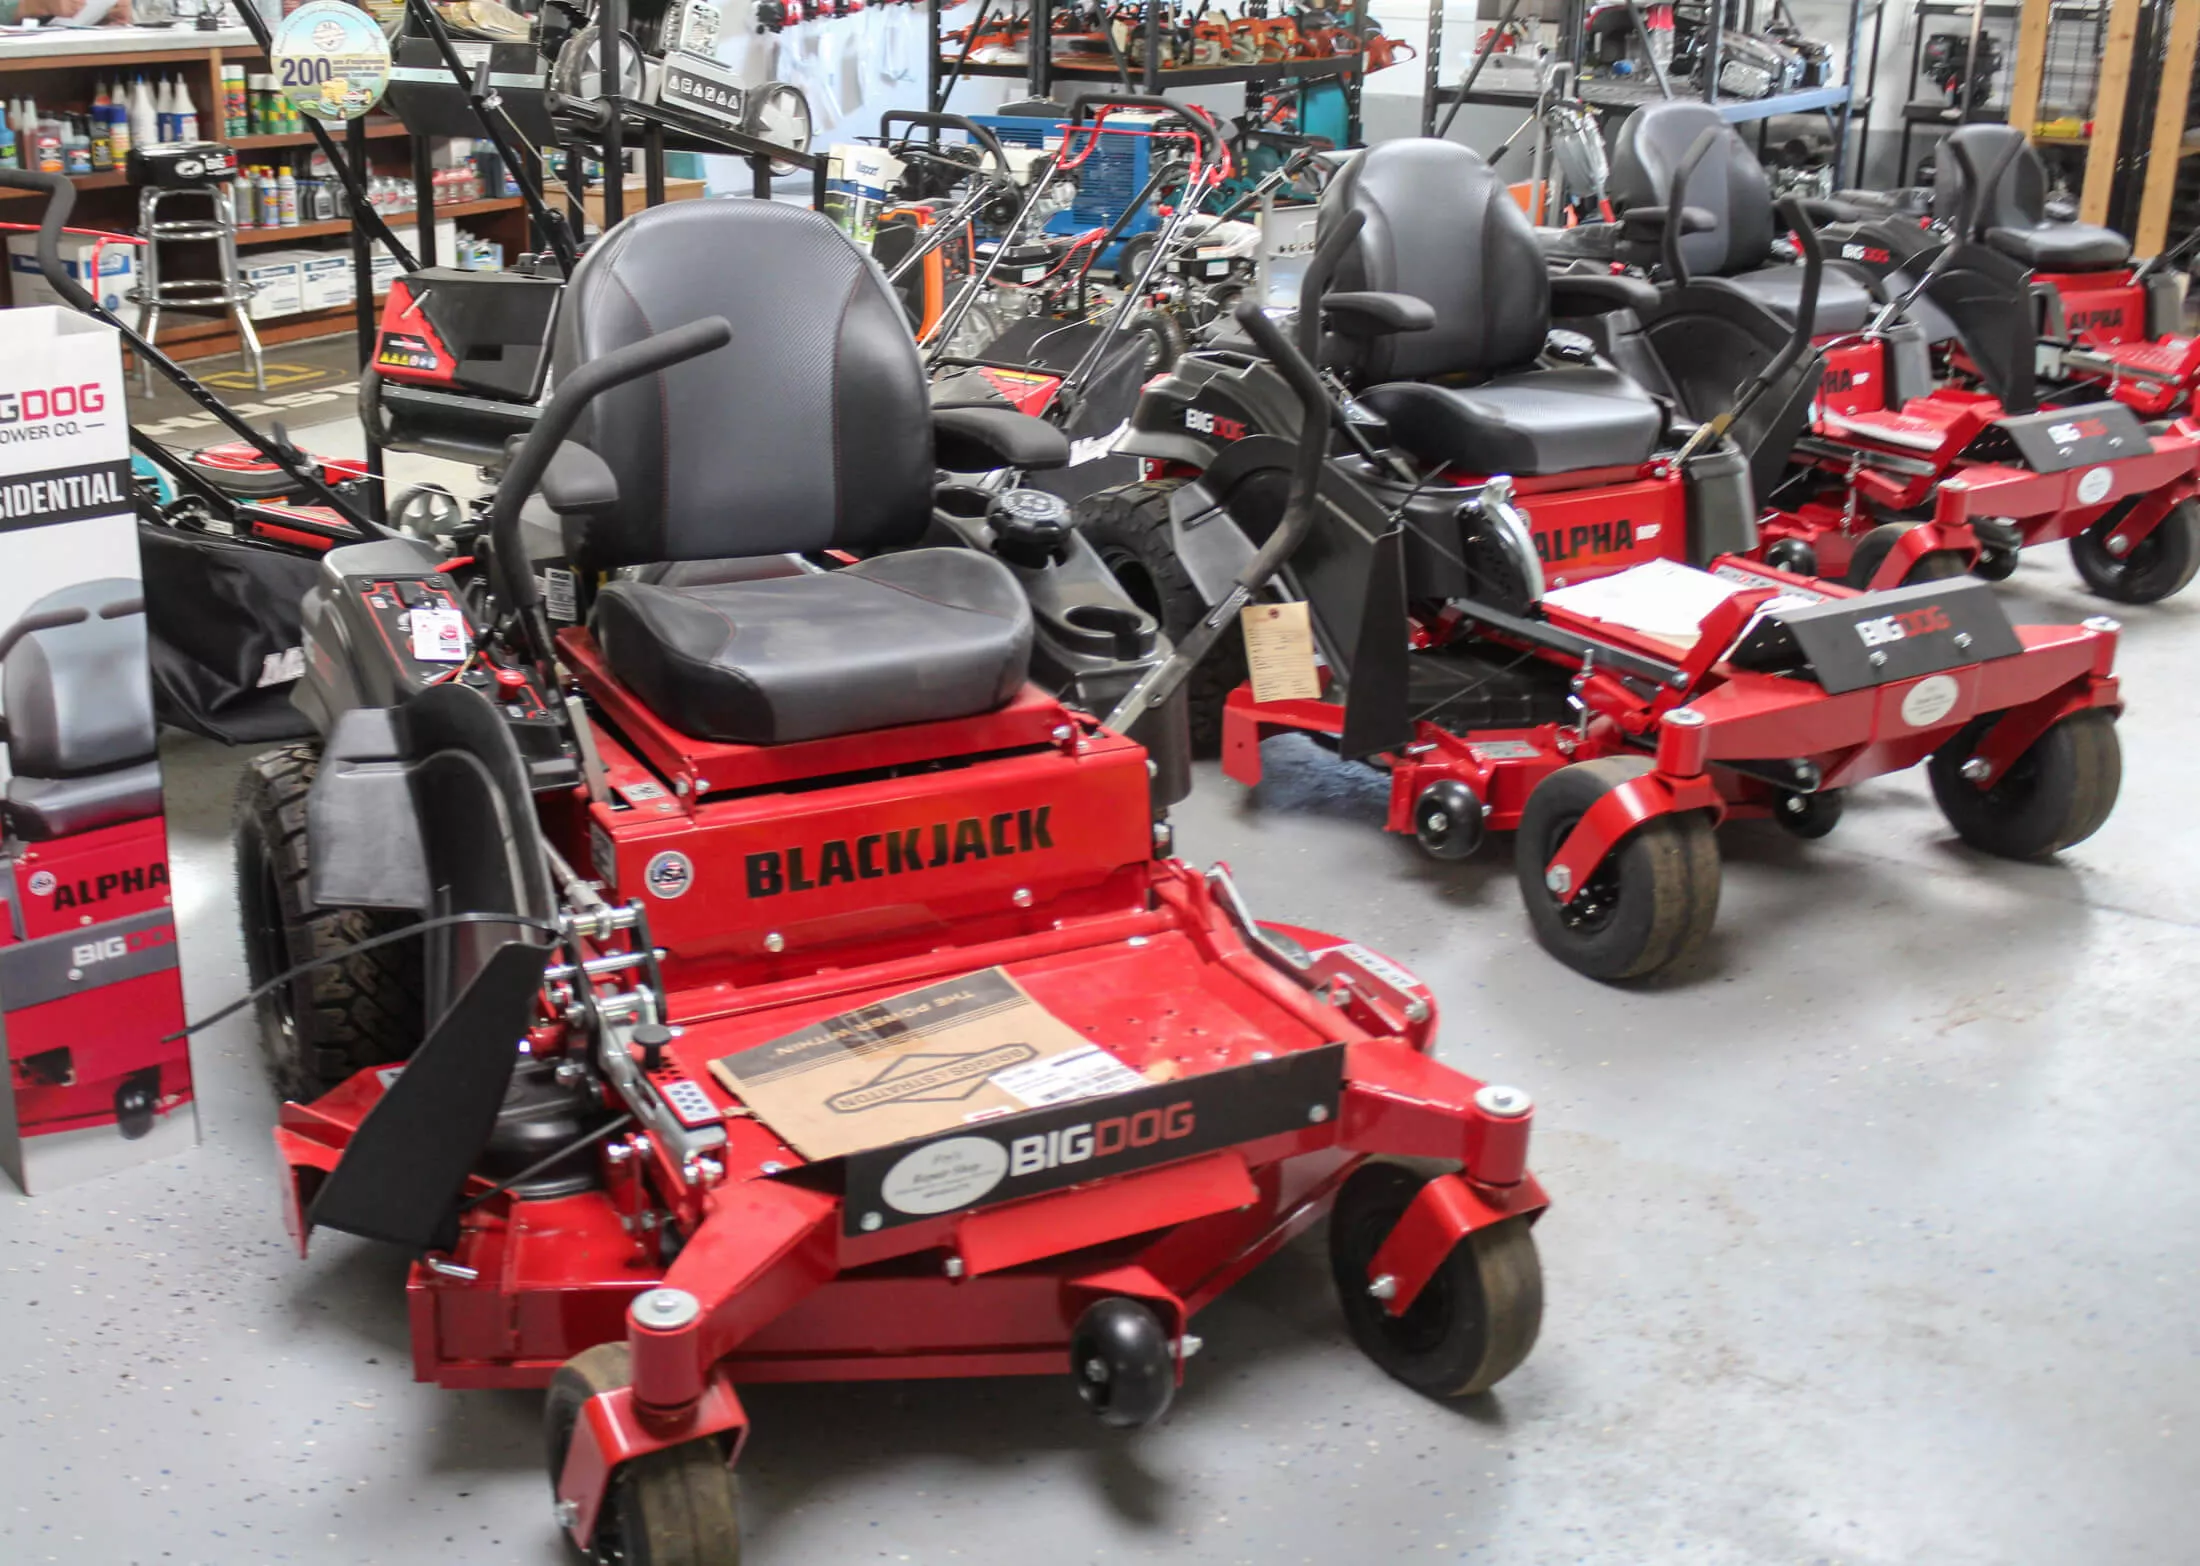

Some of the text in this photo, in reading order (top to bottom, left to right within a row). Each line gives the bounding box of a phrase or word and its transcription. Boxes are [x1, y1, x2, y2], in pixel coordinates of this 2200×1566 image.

[281, 58, 331, 86] 200
[54, 420, 81, 438] CO.
[1185, 408, 1247, 442] BIGDOG
[1532, 519, 1634, 563] ALPHA
[745, 805, 1055, 899] BLACKJACK
[53, 862, 170, 911] ALPHA
[72, 923, 177, 967] BIGDO
[775, 990, 976, 1056] THE POWER WITHIN
[950, 1048, 1025, 1077] BRIGGS
[838, 1073, 939, 1108] STRATTON
[1010, 1101, 1197, 1177] BIGDOG
